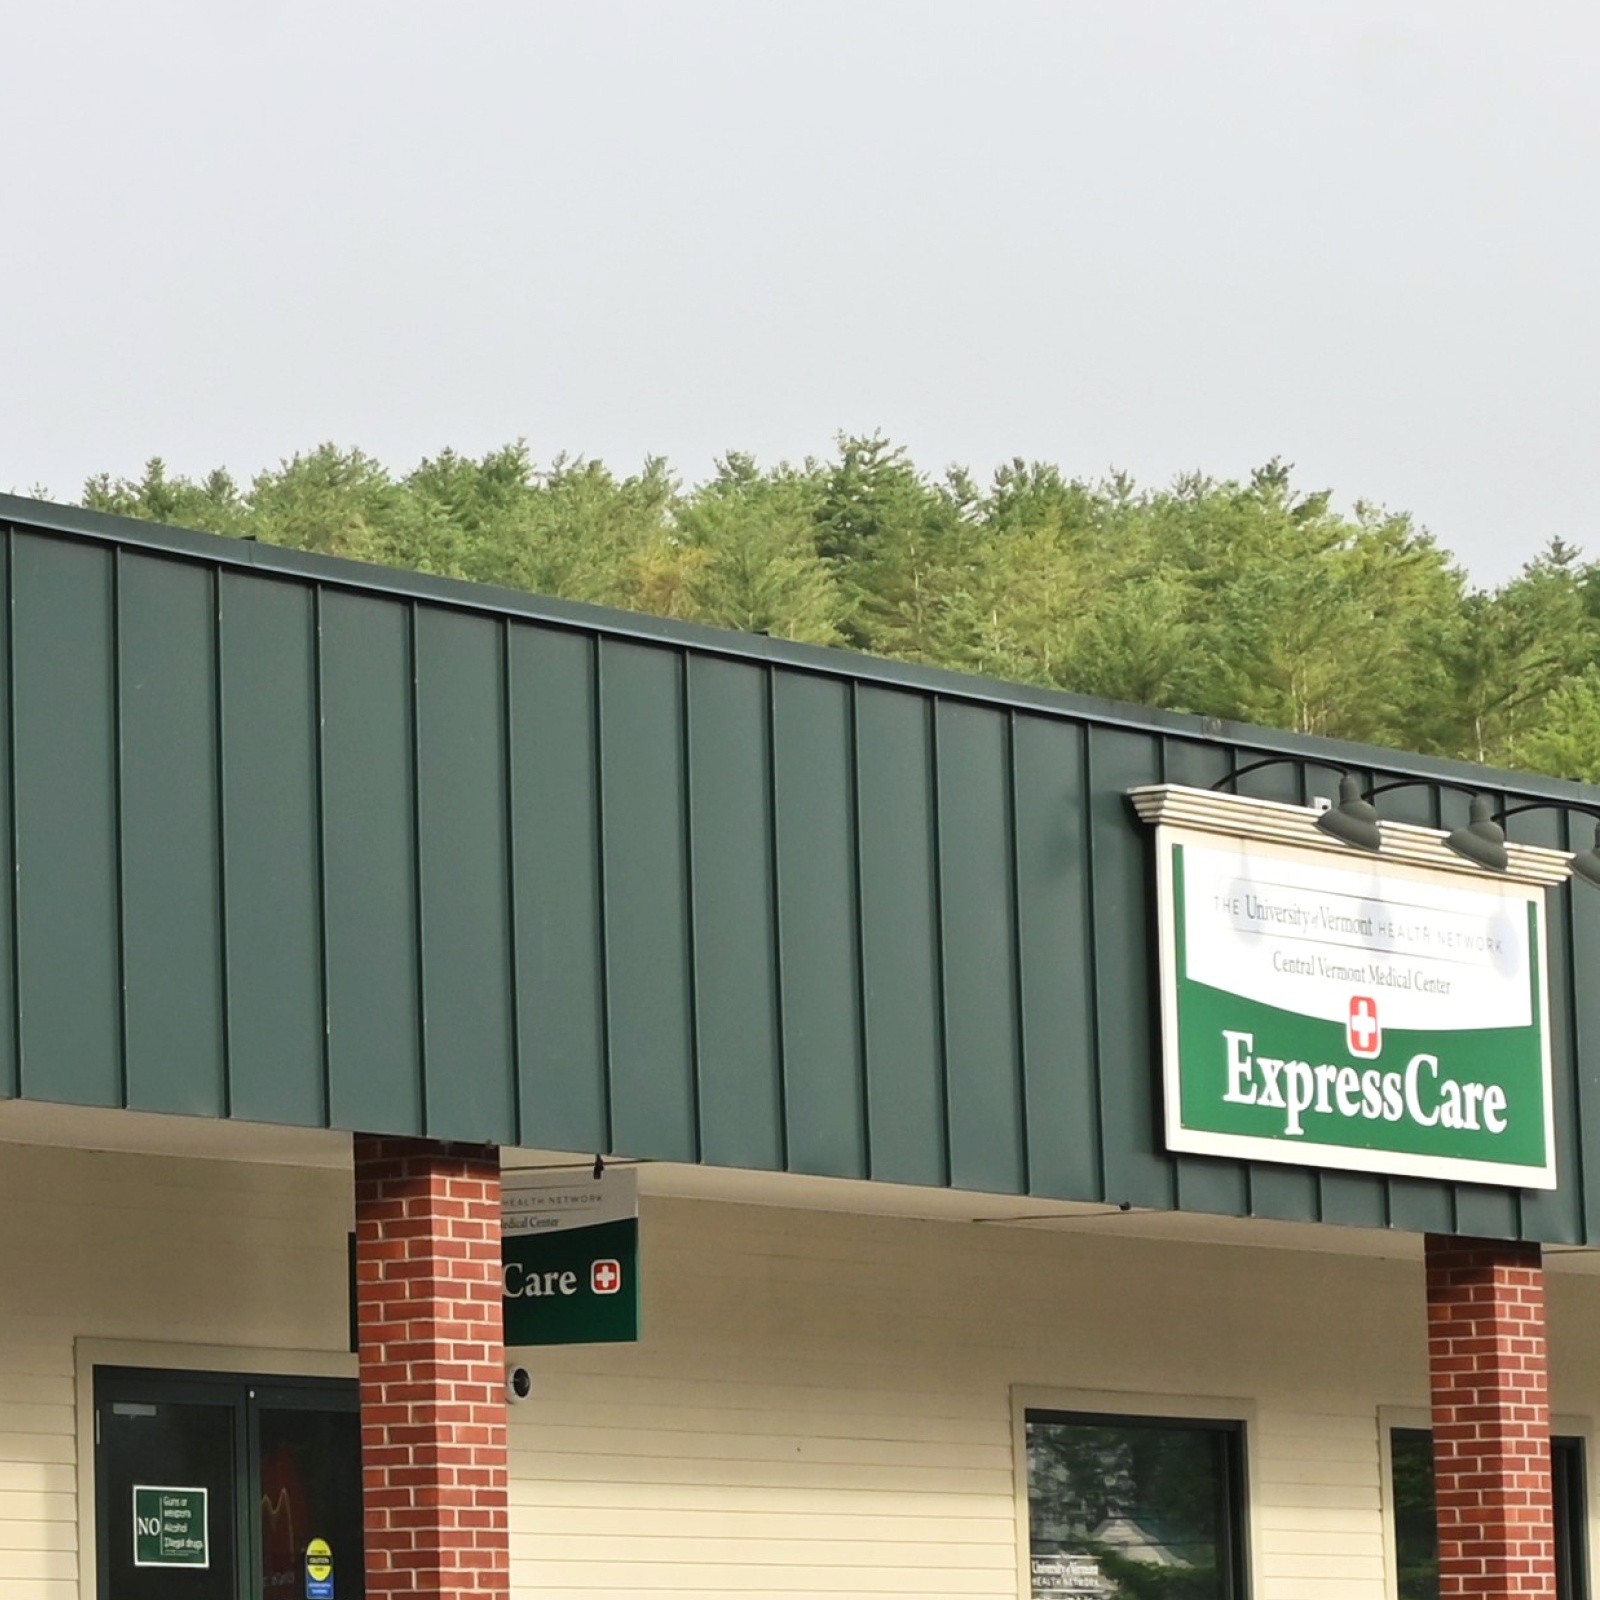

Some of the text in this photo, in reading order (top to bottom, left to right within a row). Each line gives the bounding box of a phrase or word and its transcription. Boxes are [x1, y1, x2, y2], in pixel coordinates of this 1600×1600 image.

[1214, 896, 1239, 915] THE
[1245, 894, 1310, 934] University
[1320, 906, 1373, 936] Vermont
[1378, 922, 1430, 941] HEALTH
[1438, 930, 1504, 954] NETWORK
[1273, 950, 1450, 995] Central Vermont Medical Center
[1221, 1029, 1508, 1136] ExpressCare
[549, 1194, 603, 1205] NETWORK
[530, 1216, 559, 1228] Center
[138, 1517, 160, 1536] NO
